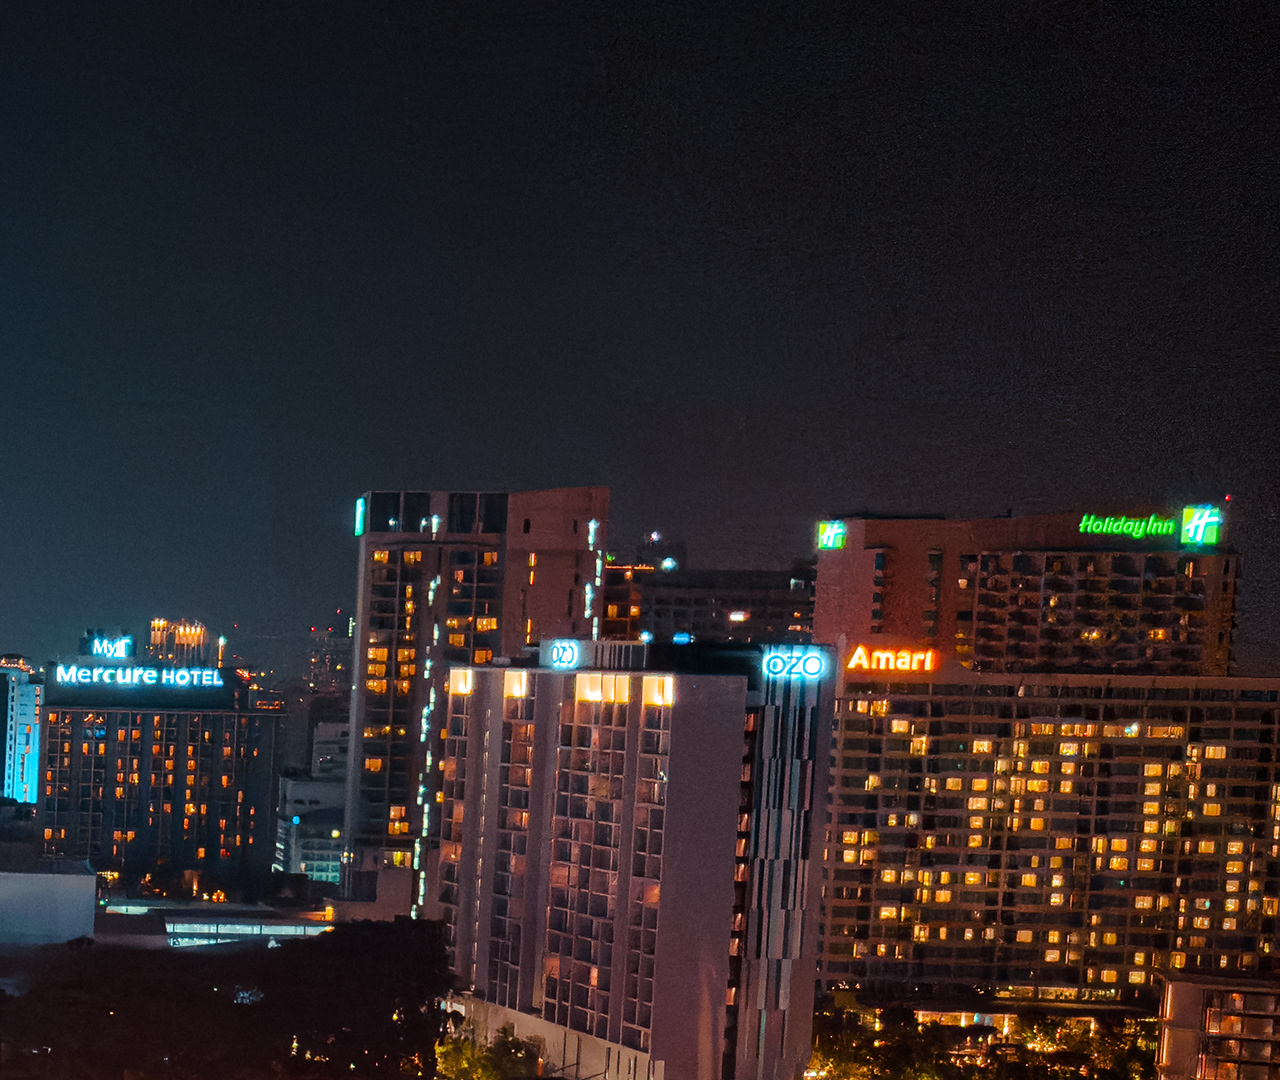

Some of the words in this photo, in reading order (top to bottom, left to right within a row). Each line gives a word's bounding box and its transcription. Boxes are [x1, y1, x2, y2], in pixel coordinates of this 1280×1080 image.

[767, 654, 823, 677] OZO
[847, 645, 933, 671] Amari
[56, 665, 158, 684] Mercure
[161, 669, 224, 686] HOTEL
